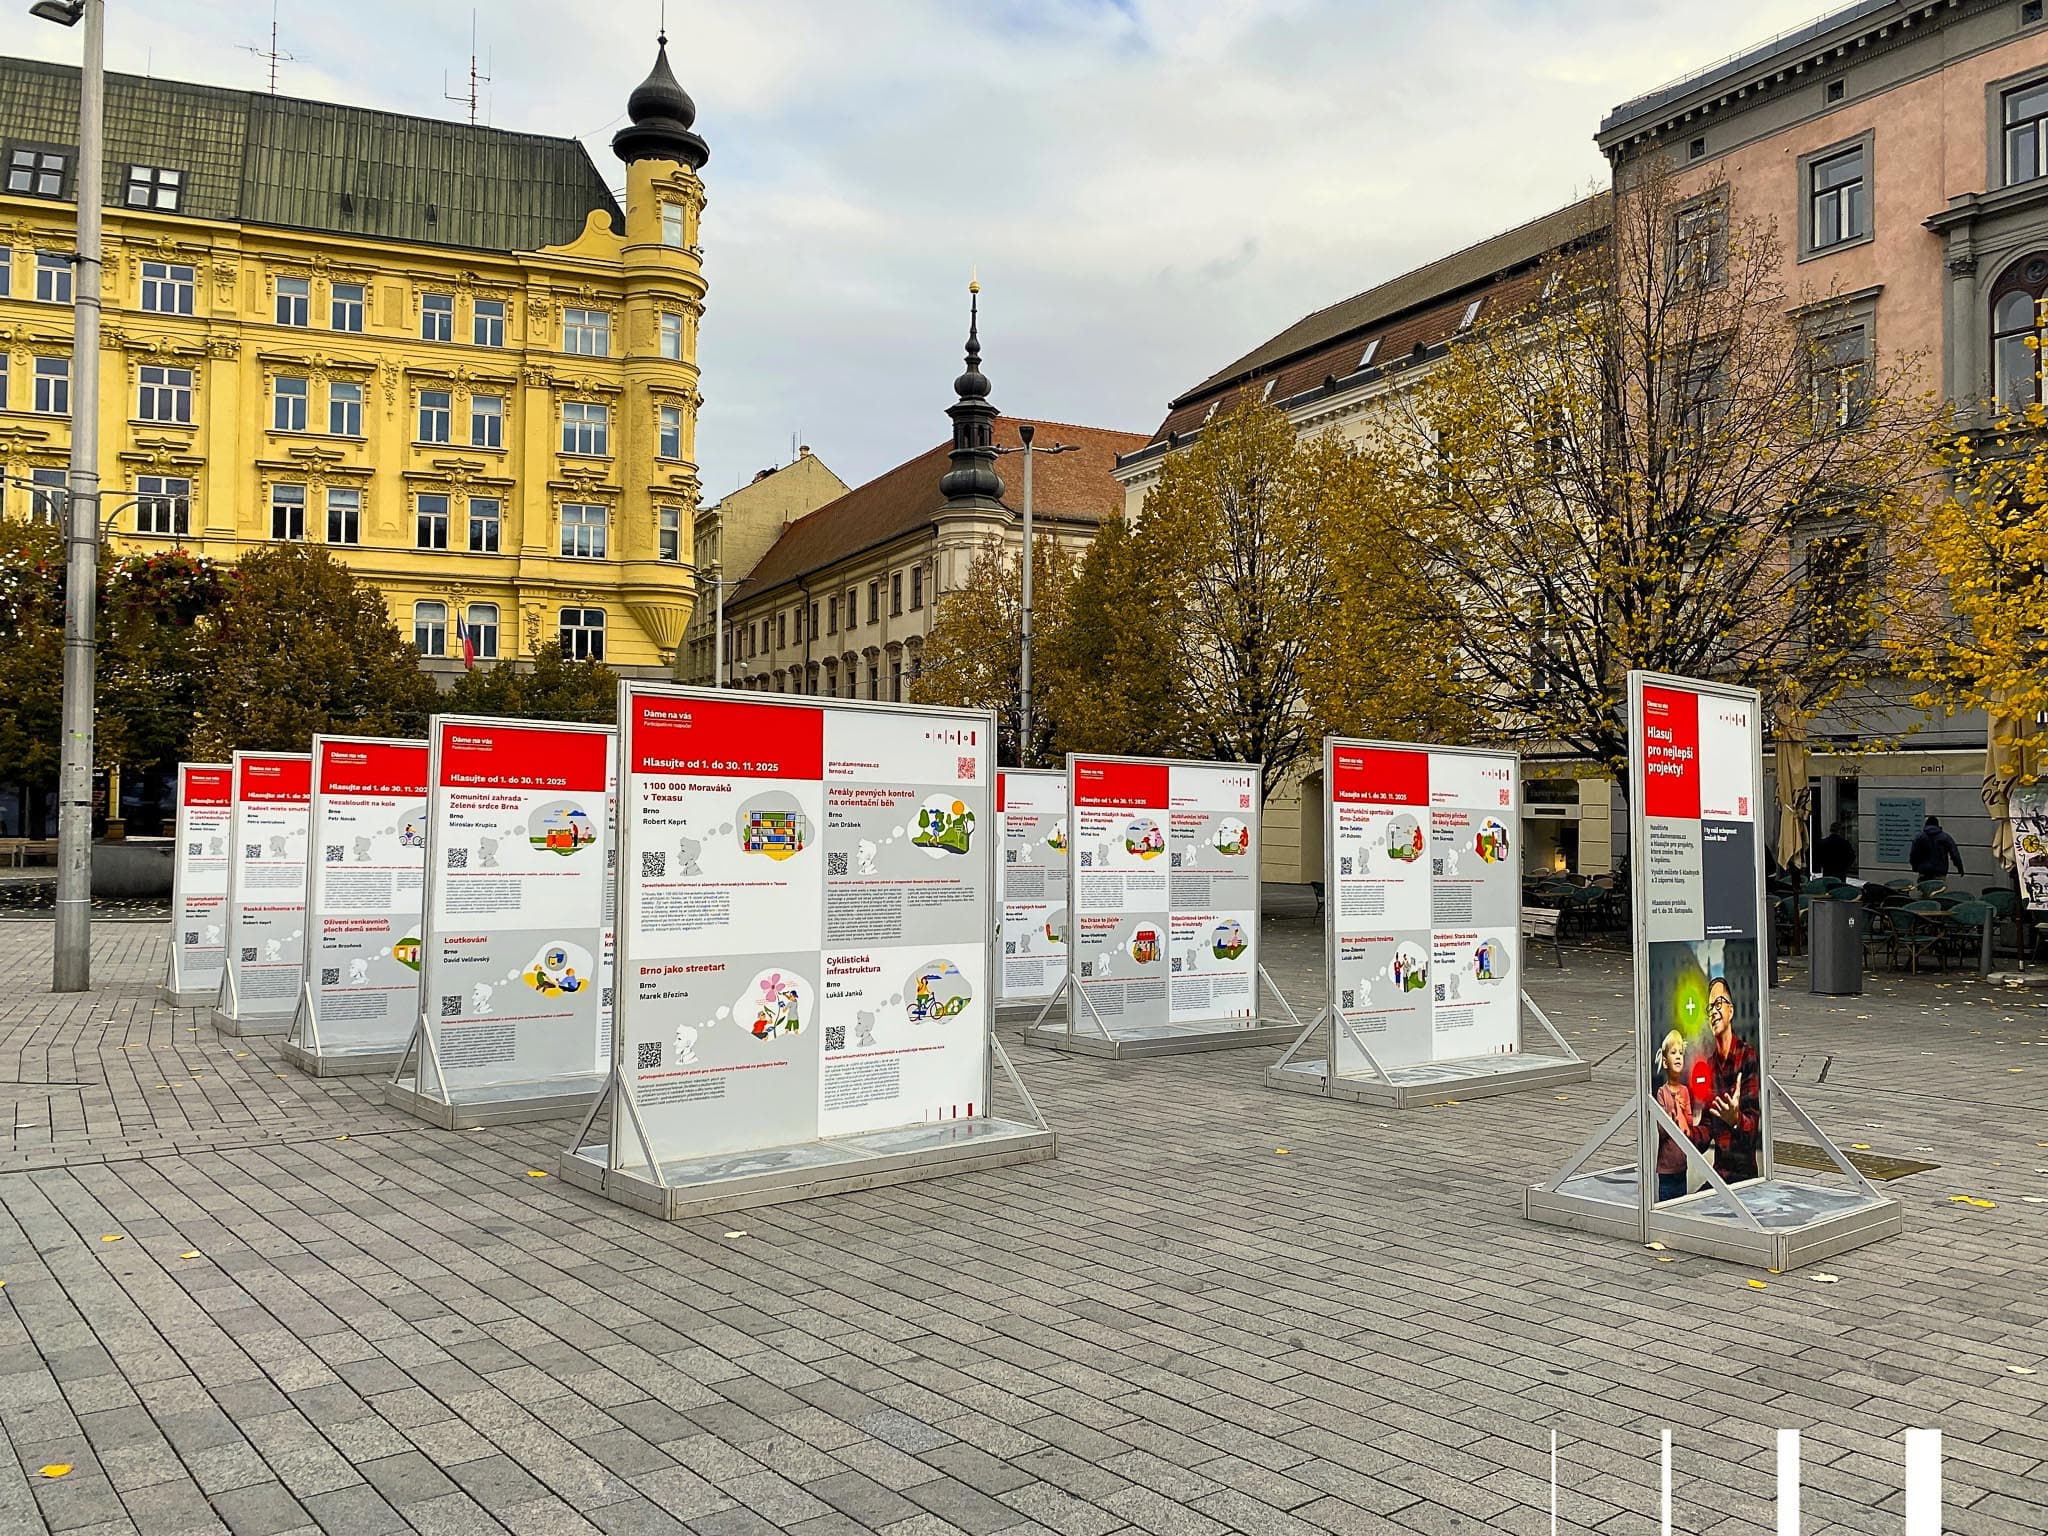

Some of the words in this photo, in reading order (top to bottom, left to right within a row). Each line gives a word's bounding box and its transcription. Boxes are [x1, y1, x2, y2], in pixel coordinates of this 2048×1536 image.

[644, 709, 666, 718] Dáme
[1647, 726, 1672, 743] Hlasuj
[452, 736, 471, 744] Dáme
[1648, 745, 1661, 758] pro
[1663, 746, 1693, 761] nejlepší
[643, 758, 684, 769] Hlasujte
[687, 760, 699, 768] od
[712, 761, 724, 769] do
[726, 762, 740, 770] 30.
[743, 762, 753, 770] 11.
[1648, 761, 1683, 777] projekty!
[451, 774, 486, 783] Hlasujte
[488, 775, 498, 783] od
[500, 776, 507, 784] 1.
[689, 783, 731, 792] Moraváků
[450, 793, 490, 801] Komunitní
[829, 788, 853, 798] Areály
[856, 788, 885, 798] pevných
[888, 790, 915, 798] kontrol
[1339, 791, 1360, 799] Hlasujte
[478, 802, 499, 810] srdce
[881, 799, 894, 807] běh
[324, 926, 343, 934] ploch
[444, 936, 488, 944] Loutkování
[827, 955, 870, 966] Cyklistická
[640, 966, 662, 975] Brno
[664, 965, 683, 975] jako
[685, 963, 725, 973] streetart
[827, 966, 881, 976] infrastruktura
[640, 992, 661, 1000] Marek
[663, 991, 688, 999] Březina
[601, 1169, 606, 1191] 2
